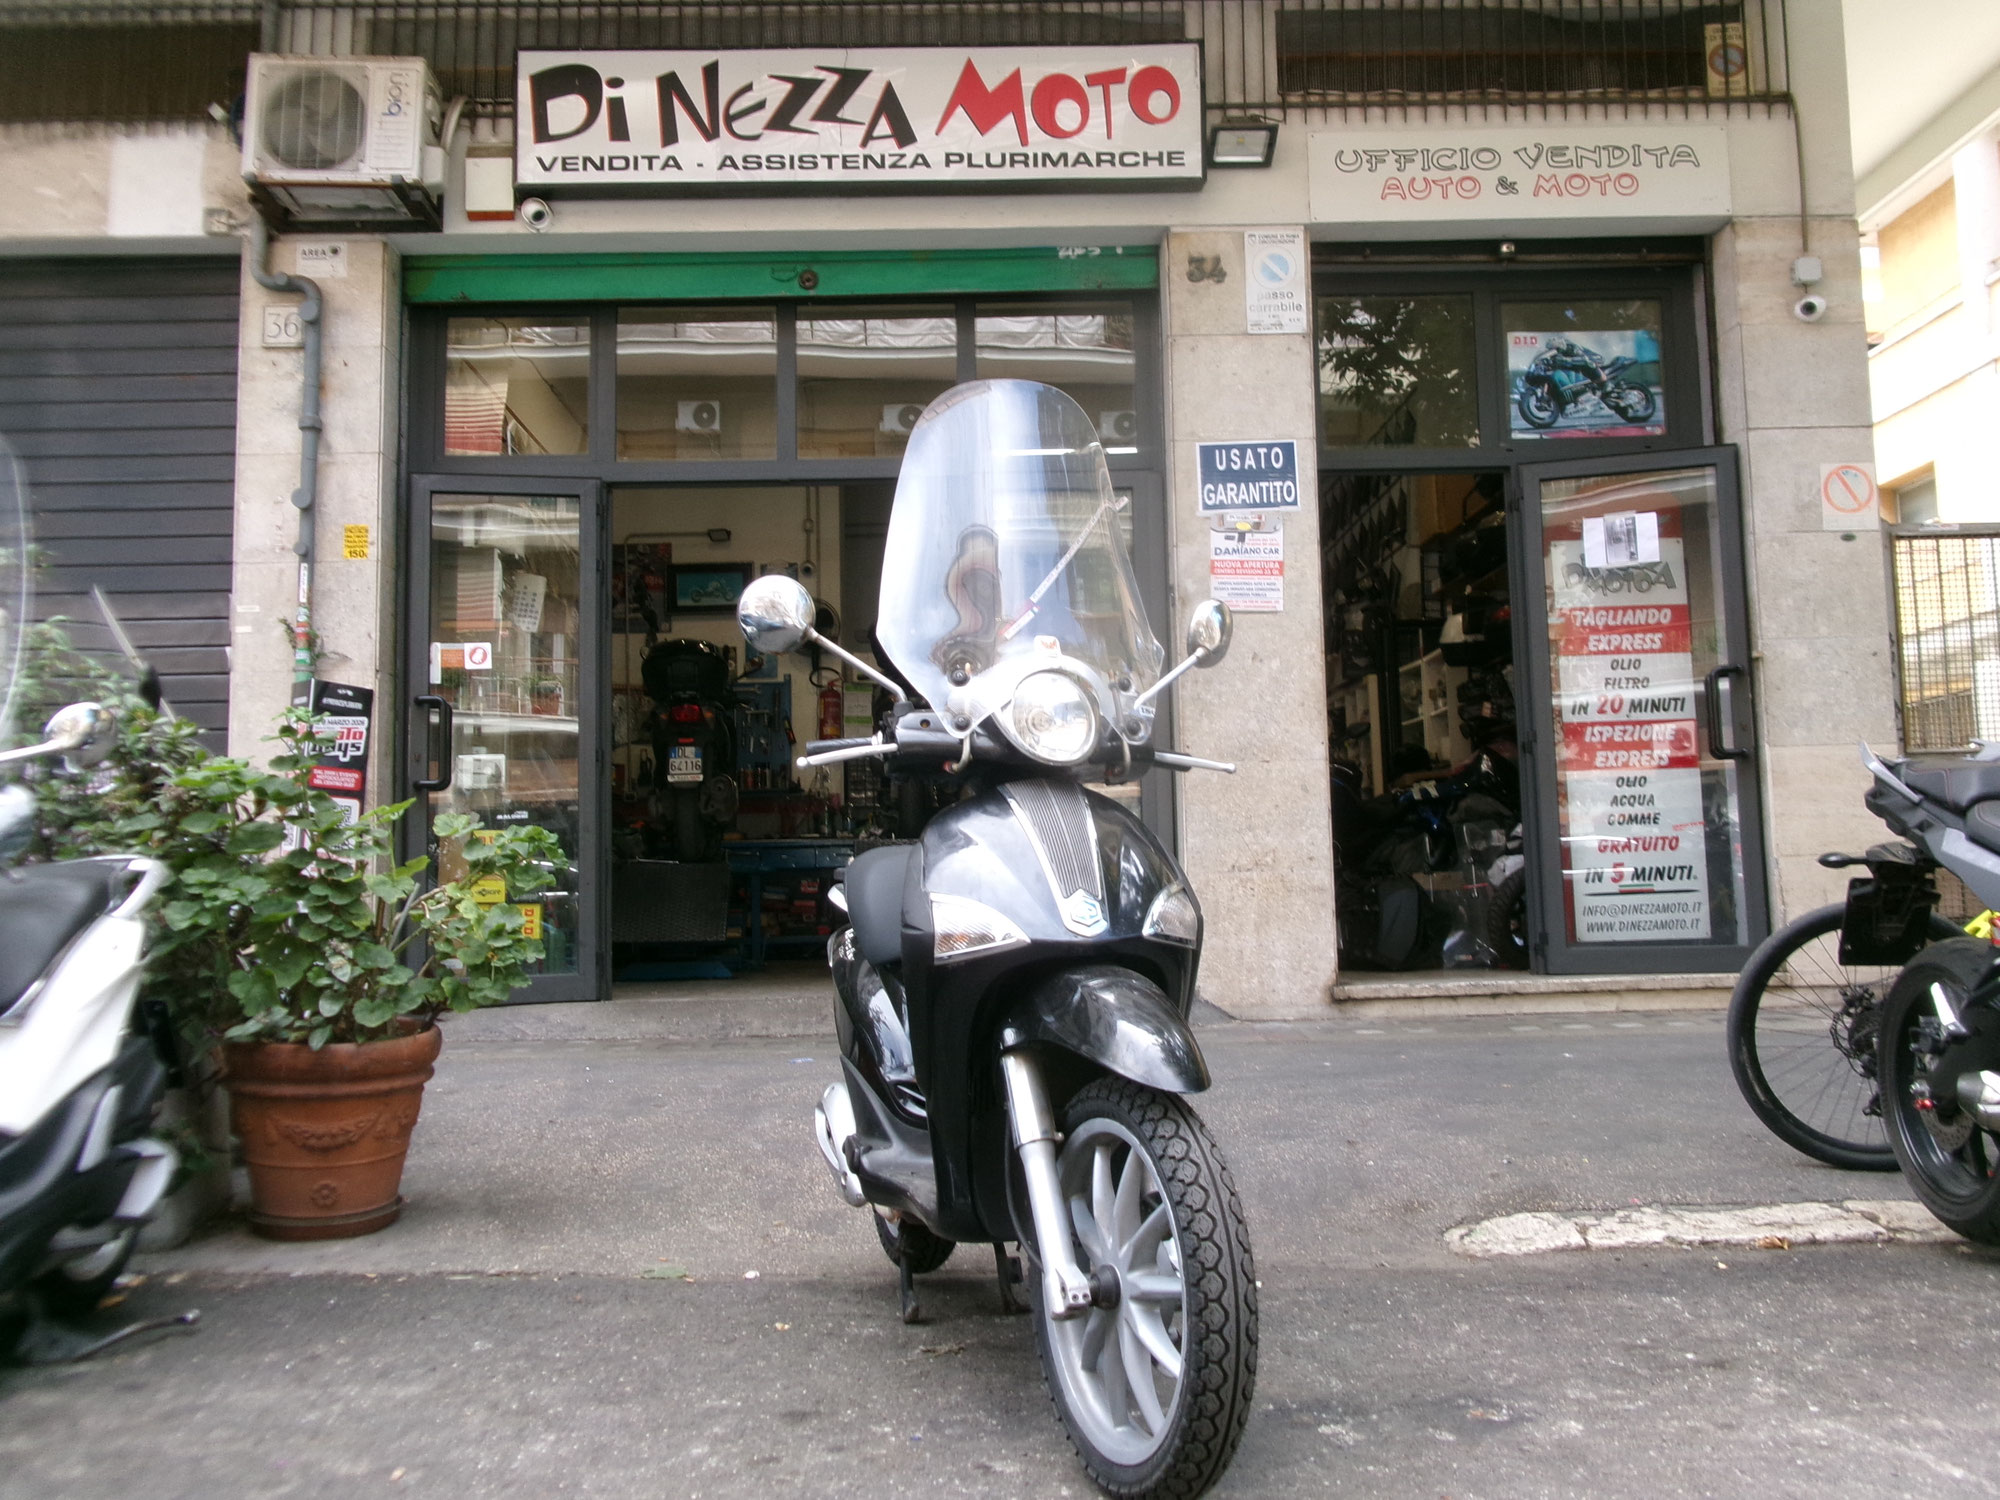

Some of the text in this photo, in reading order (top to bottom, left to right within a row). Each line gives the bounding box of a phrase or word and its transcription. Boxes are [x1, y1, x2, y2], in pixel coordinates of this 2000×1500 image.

[529, 63, 631, 144] Di
[935, 56, 1180, 147] MOTO
[536, 155, 683, 172] VENDITA
[716, 153, 932, 171] ASSISTENZA
[945, 150, 1186, 169] PLURIMARCHE
[1335, 142, 1700, 173] UFFICIO VENDITA
[1380, 172, 1639, 201] AUTO & MOTO
[1257, 291, 1294, 302] passo
[1249, 301, 1303, 312] carrabile
[266, 312, 300, 340] 36
[1215, 447, 1284, 471] USATO
[1203, 480, 1296, 506] GARANTITO
[1214, 546, 1280, 556] DAMIANO CAR
[1243, 561, 1280, 569] APERTURA
[1574, 608, 1672, 627] TAGLIANDO
[1588, 633, 1664, 651] EXPRESS
[1610, 659, 1641, 671] OLIO
[1604, 677, 1650, 690] FILTRO
[1571, 695, 1686, 716] IN 20 MINUTI
[1585, 723, 1677, 743] ISPEZIONE
[1595, 749, 1671, 768] EXPRESS
[1616, 775, 1647, 788] OLIO
[1610, 794, 1655, 808] ACQUA
[1608, 813, 1661, 826] GOMME
[1598, 835, 1680, 854] GRATUITO
[1584, 870, 1604, 884] IN
[1610, 862, 1625, 883] 5
[1583, 901, 1703, 917] INFO@DINEZZAMOTO.IT
[1586, 918, 1701, 934] WWW.DINEZZAMOTO.IT
